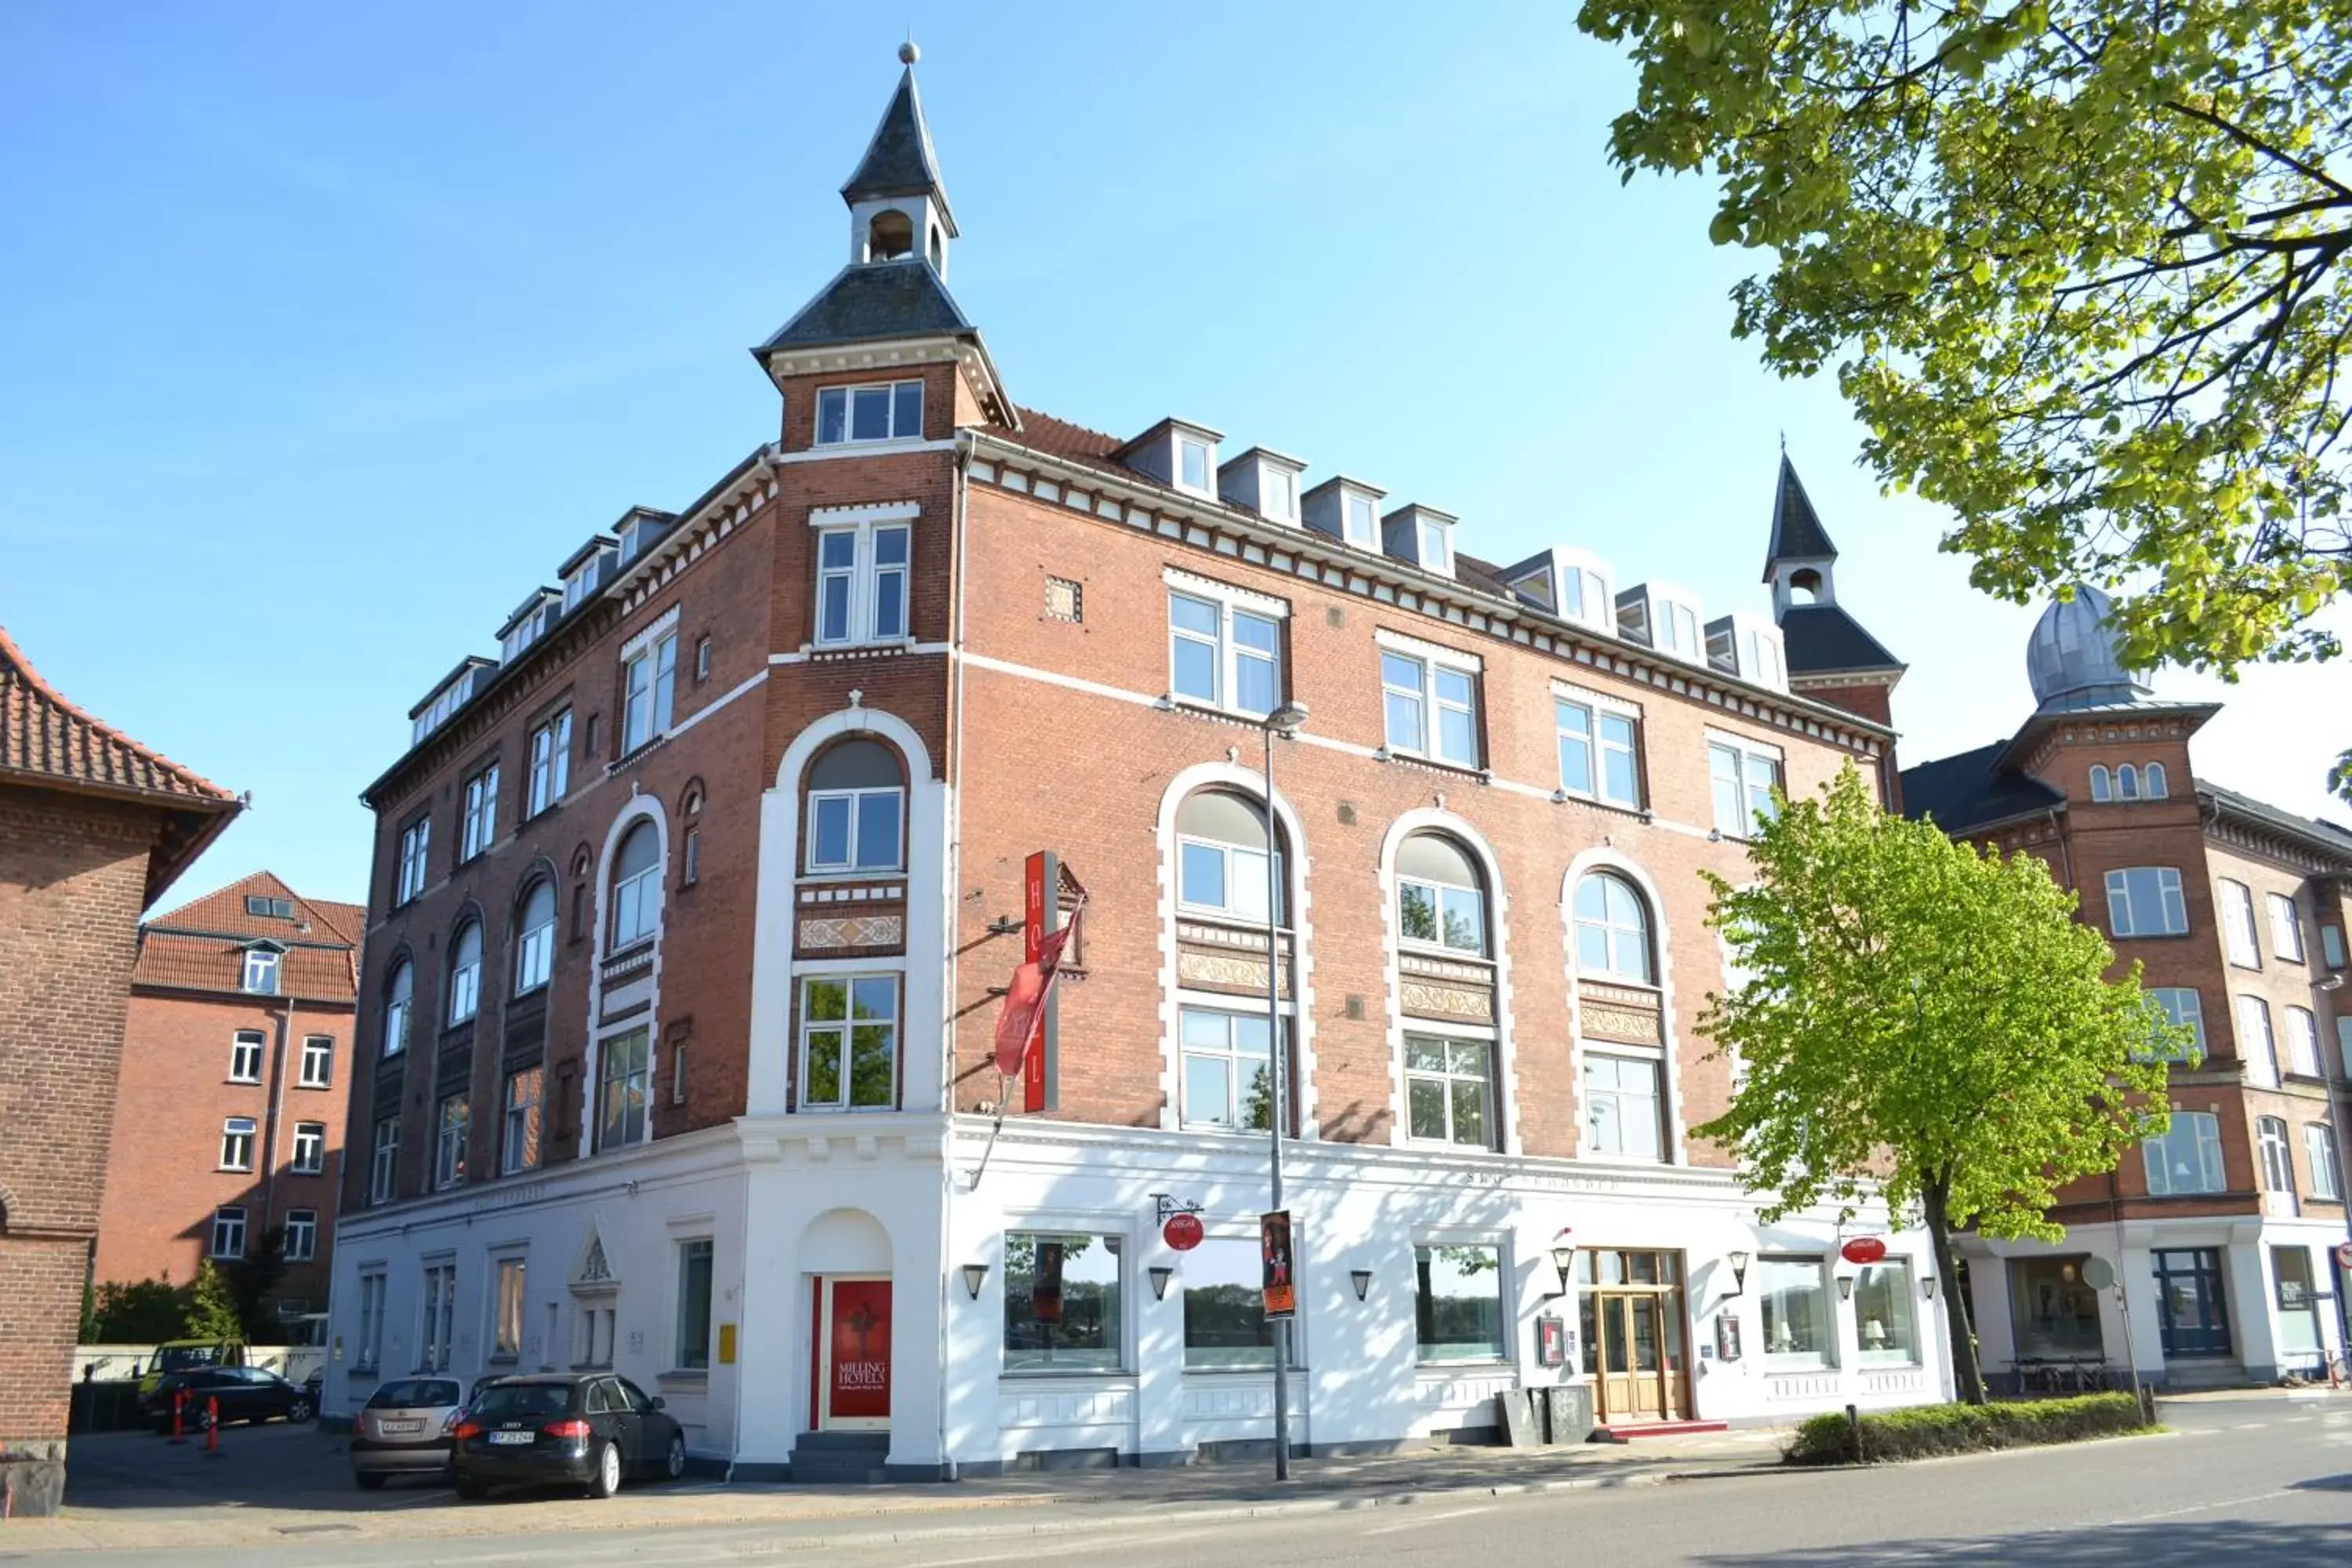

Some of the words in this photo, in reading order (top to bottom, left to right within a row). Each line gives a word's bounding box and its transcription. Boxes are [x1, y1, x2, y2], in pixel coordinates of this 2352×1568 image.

[1031, 880, 1042, 1083] HOL
[839, 1362, 885, 1374] MILLING
[839, 1372, 885, 1384] HOTELS
